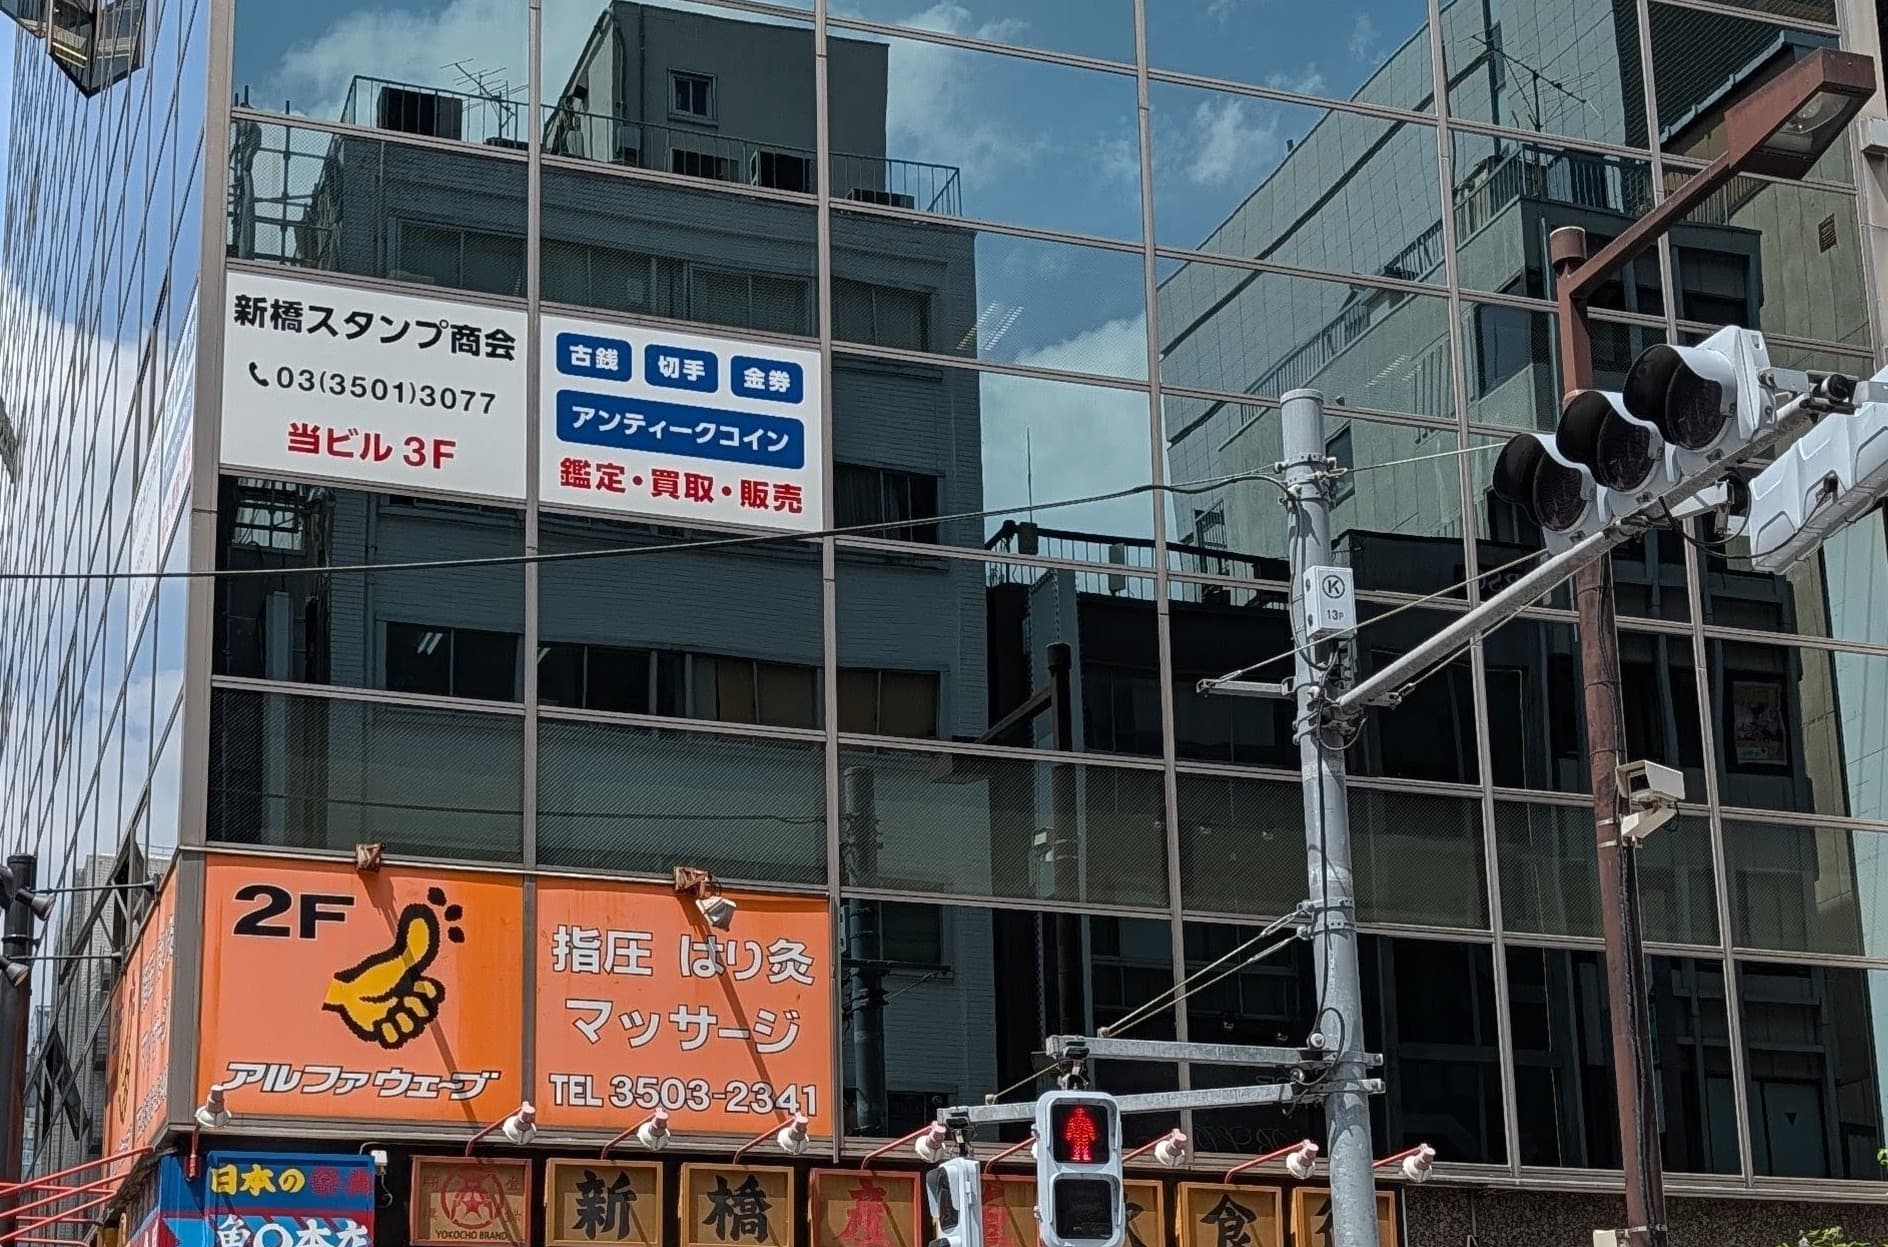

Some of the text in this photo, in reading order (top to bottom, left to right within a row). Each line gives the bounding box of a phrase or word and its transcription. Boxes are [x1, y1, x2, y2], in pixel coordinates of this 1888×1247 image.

[233, 294, 517, 361] 新橋スタンプ商会
[568, 343, 619, 371] 古銭
[656, 354, 706, 384] 切手
[743, 366, 791, 394] 金券
[276, 365, 497, 415] 03(3501)3077
[571, 404, 790, 453] アンティークコイン
[231, 883, 356, 941] 2F
[552, 923, 816, 986] 指圧 はり灸
[564, 997, 801, 1055] マッサージ
[220, 1060, 502, 1101] アルファウェーブ
[548, 1073, 817, 1116] TEL 3503-2341
[435, 1230, 508, 1241] YOKOCHO BRAND
